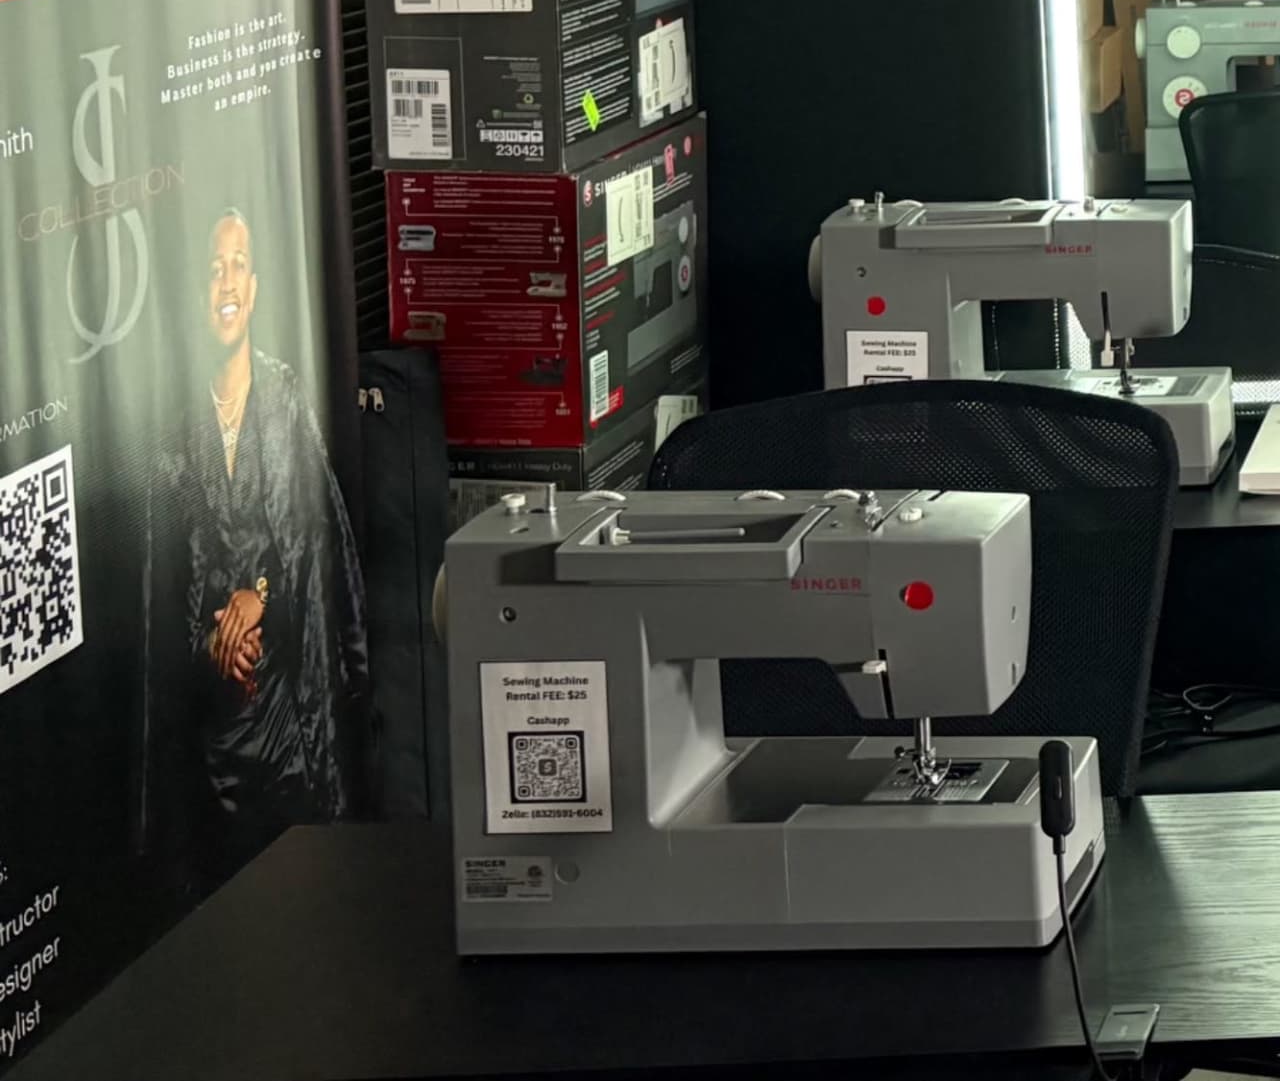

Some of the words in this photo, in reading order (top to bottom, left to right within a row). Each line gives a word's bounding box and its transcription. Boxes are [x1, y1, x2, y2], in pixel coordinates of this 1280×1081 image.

[188, 28, 231, 50] Fashion
[235, 23, 245, 37] is
[249, 18, 265, 33] the
[268, 11, 287, 26] art.
[167, 54, 219, 79] Business
[223, 49, 233, 62] is
[236, 44, 254, 59] the
[258, 30, 306, 52] strategy.
[161, 81, 203, 104] Master
[207, 72, 233, 91] both
[236, 64, 257, 81] and
[259, 58, 277, 77] you
[279, 48, 321, 67] create
[215, 97, 227, 111] an
[231, 84, 271, 104] empire.
[496, 145, 544, 157] 230421
[18, 164, 184, 241] COLLECTION
[1045, 244, 1092, 255] SINGER
[791, 577, 862, 590] SINGER
[503, 676, 541, 688] Sewing
[543, 675, 589, 686] Machine
[506, 691, 540, 701] Rental
[542, 690, 566, 701] FEE:
[567, 689, 588, 700] $25
[527, 716, 570, 726] Cashapp
[501, 809, 530, 820] Zelle:
